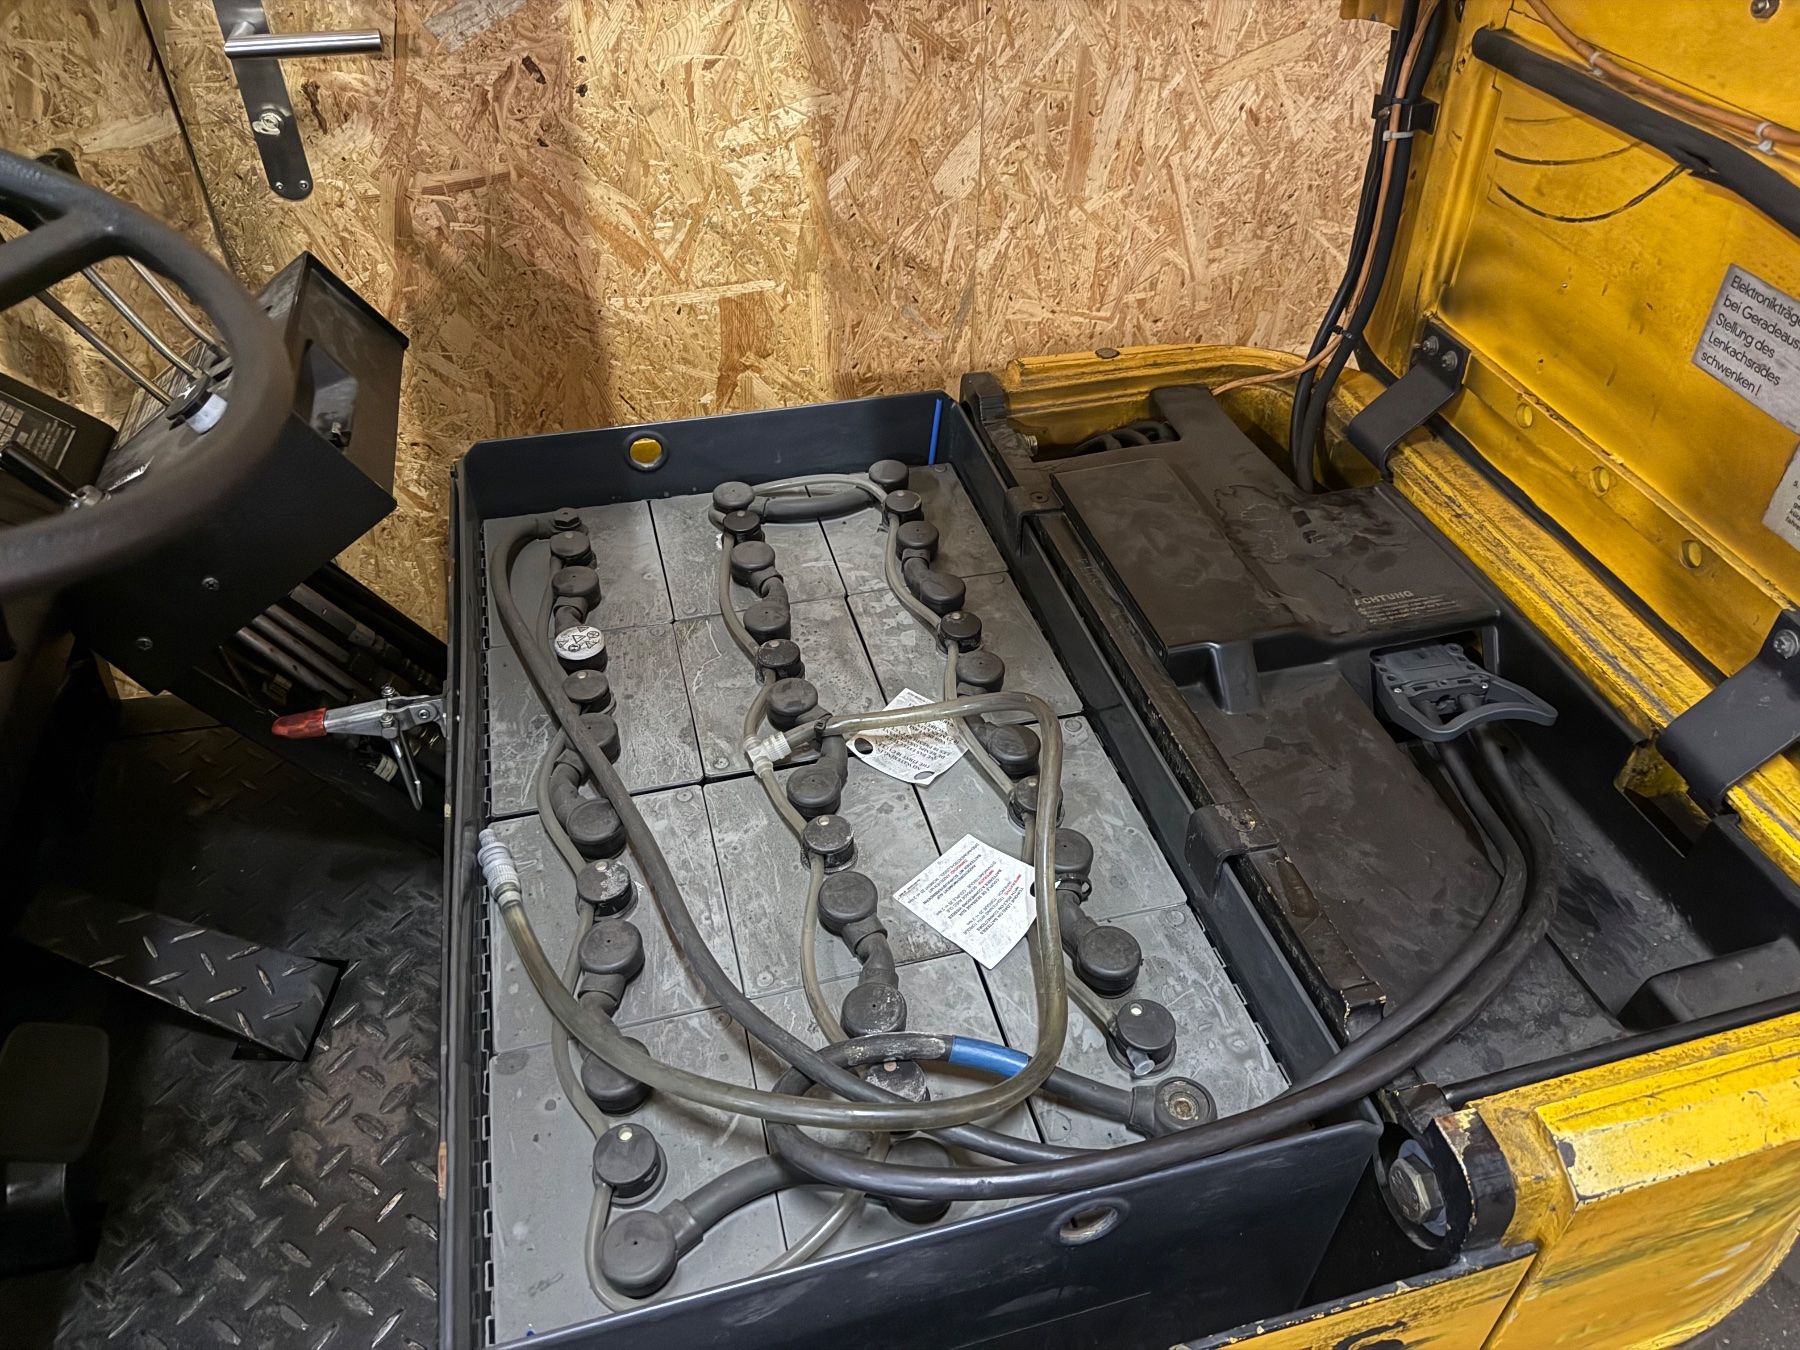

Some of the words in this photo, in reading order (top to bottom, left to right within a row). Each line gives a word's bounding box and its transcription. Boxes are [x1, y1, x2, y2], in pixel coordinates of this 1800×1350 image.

[1723, 294, 1742, 314] bei
[1716, 313, 1754, 348] Stellung
[1754, 337, 1775, 359] des
[1701, 351, 1755, 393] schwenken
[1708, 331, 1781, 386] Lenkachsrades
[1355, 590, 1414, 606] ACHTUNG
